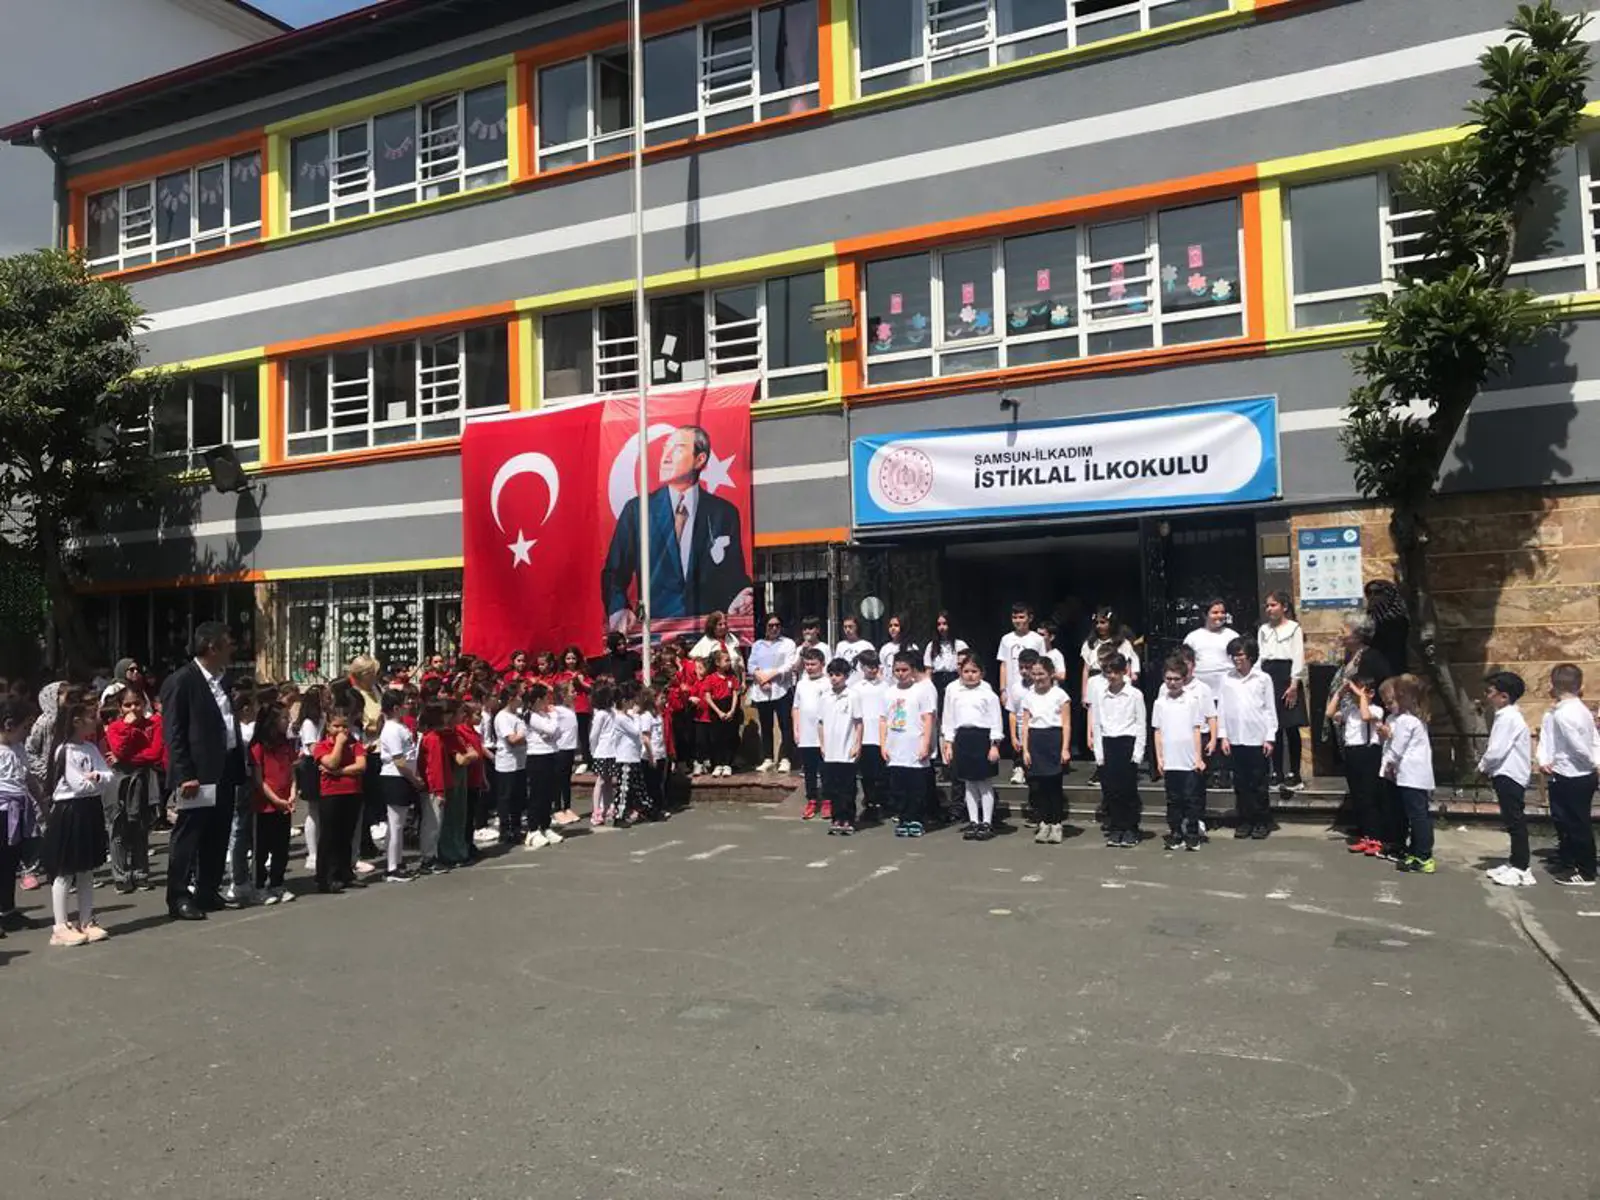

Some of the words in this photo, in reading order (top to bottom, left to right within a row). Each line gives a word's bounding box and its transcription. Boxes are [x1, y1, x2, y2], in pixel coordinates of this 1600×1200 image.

[974, 445, 1093, 466] SAMSUN-İLKADIM
[974, 464, 1077, 489] İSTİKLAL
[1084, 454, 1208, 482] İLKOKULU
